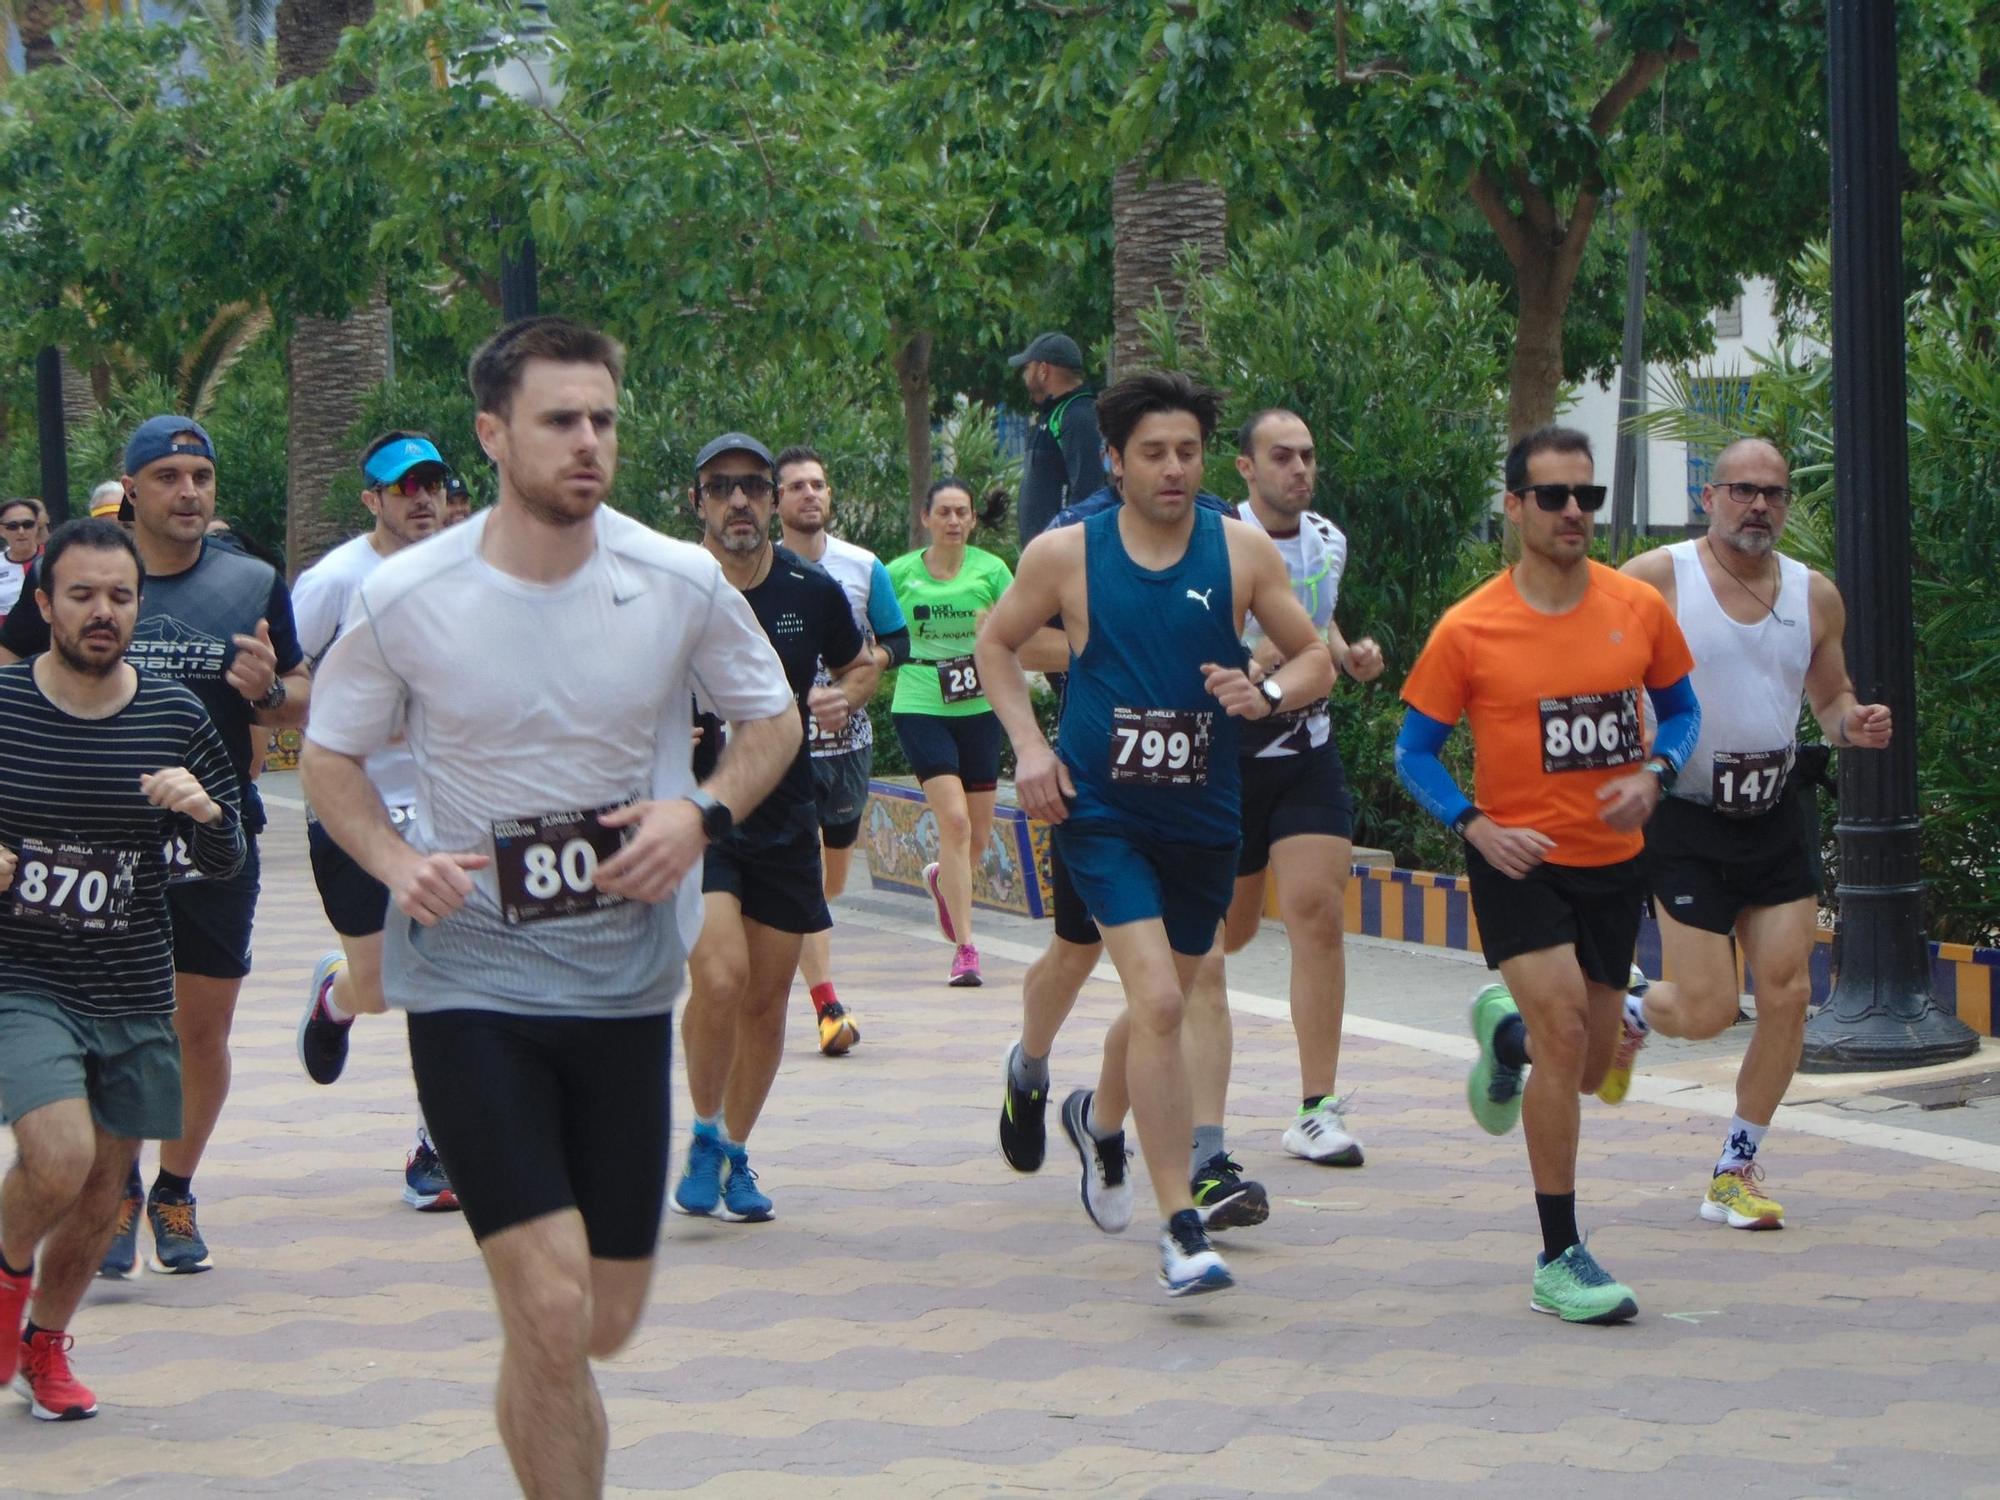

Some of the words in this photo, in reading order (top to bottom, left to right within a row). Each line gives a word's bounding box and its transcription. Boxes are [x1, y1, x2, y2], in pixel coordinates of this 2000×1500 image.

[949, 667, 977, 693] 28
[1116, 727, 1190, 770] 799
[1545, 712, 1619, 757] 806
[1719, 767, 1780, 803] 147
[19, 860, 109, 913] 870
[524, 837, 598, 900] 80
